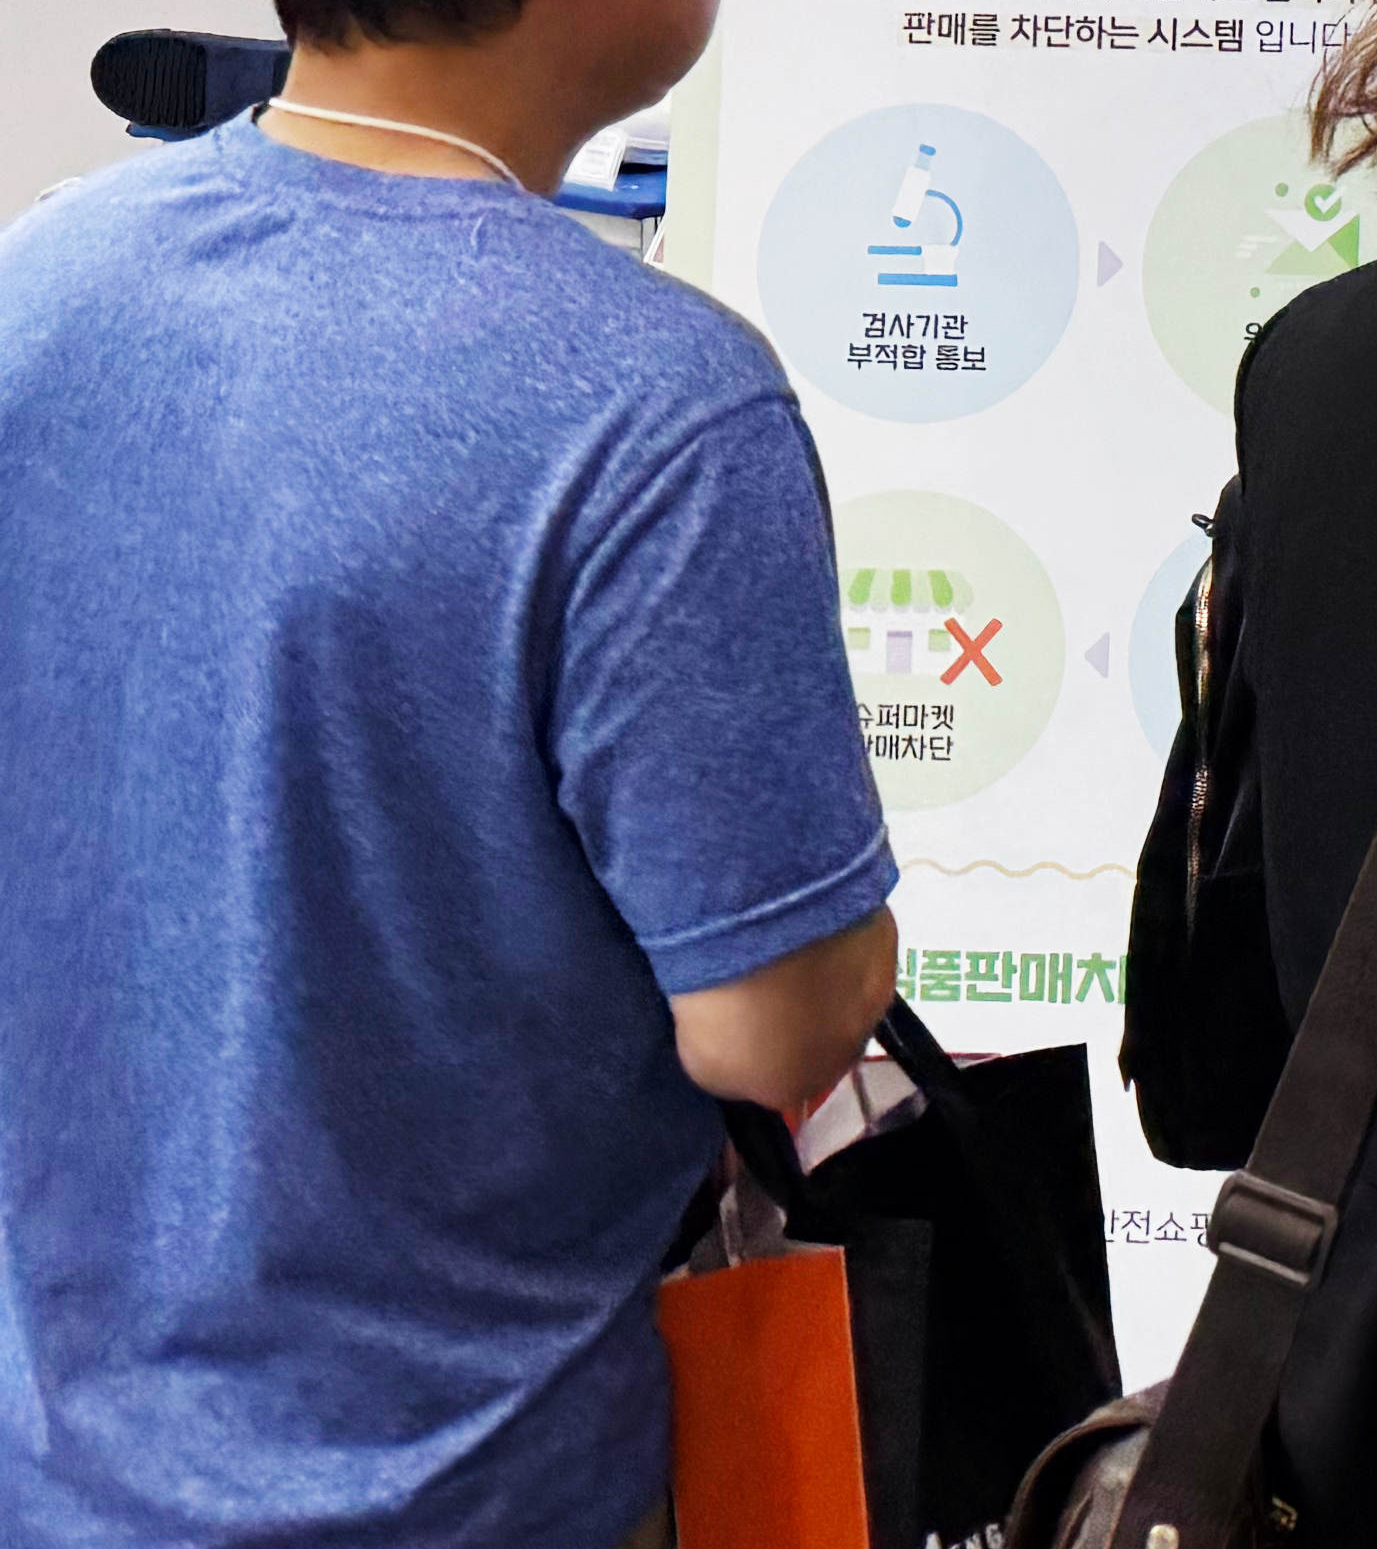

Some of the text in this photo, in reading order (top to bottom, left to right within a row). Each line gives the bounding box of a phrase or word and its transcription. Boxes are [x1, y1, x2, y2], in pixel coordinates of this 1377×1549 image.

[903, 12, 1352, 54] 판매를 차단하는 시스템 입니다
[863, 312, 969, 340] 검사기관
[847, 342, 987, 371] 부적합 통보
[859, 703, 954, 731] 슈퍼마켓
